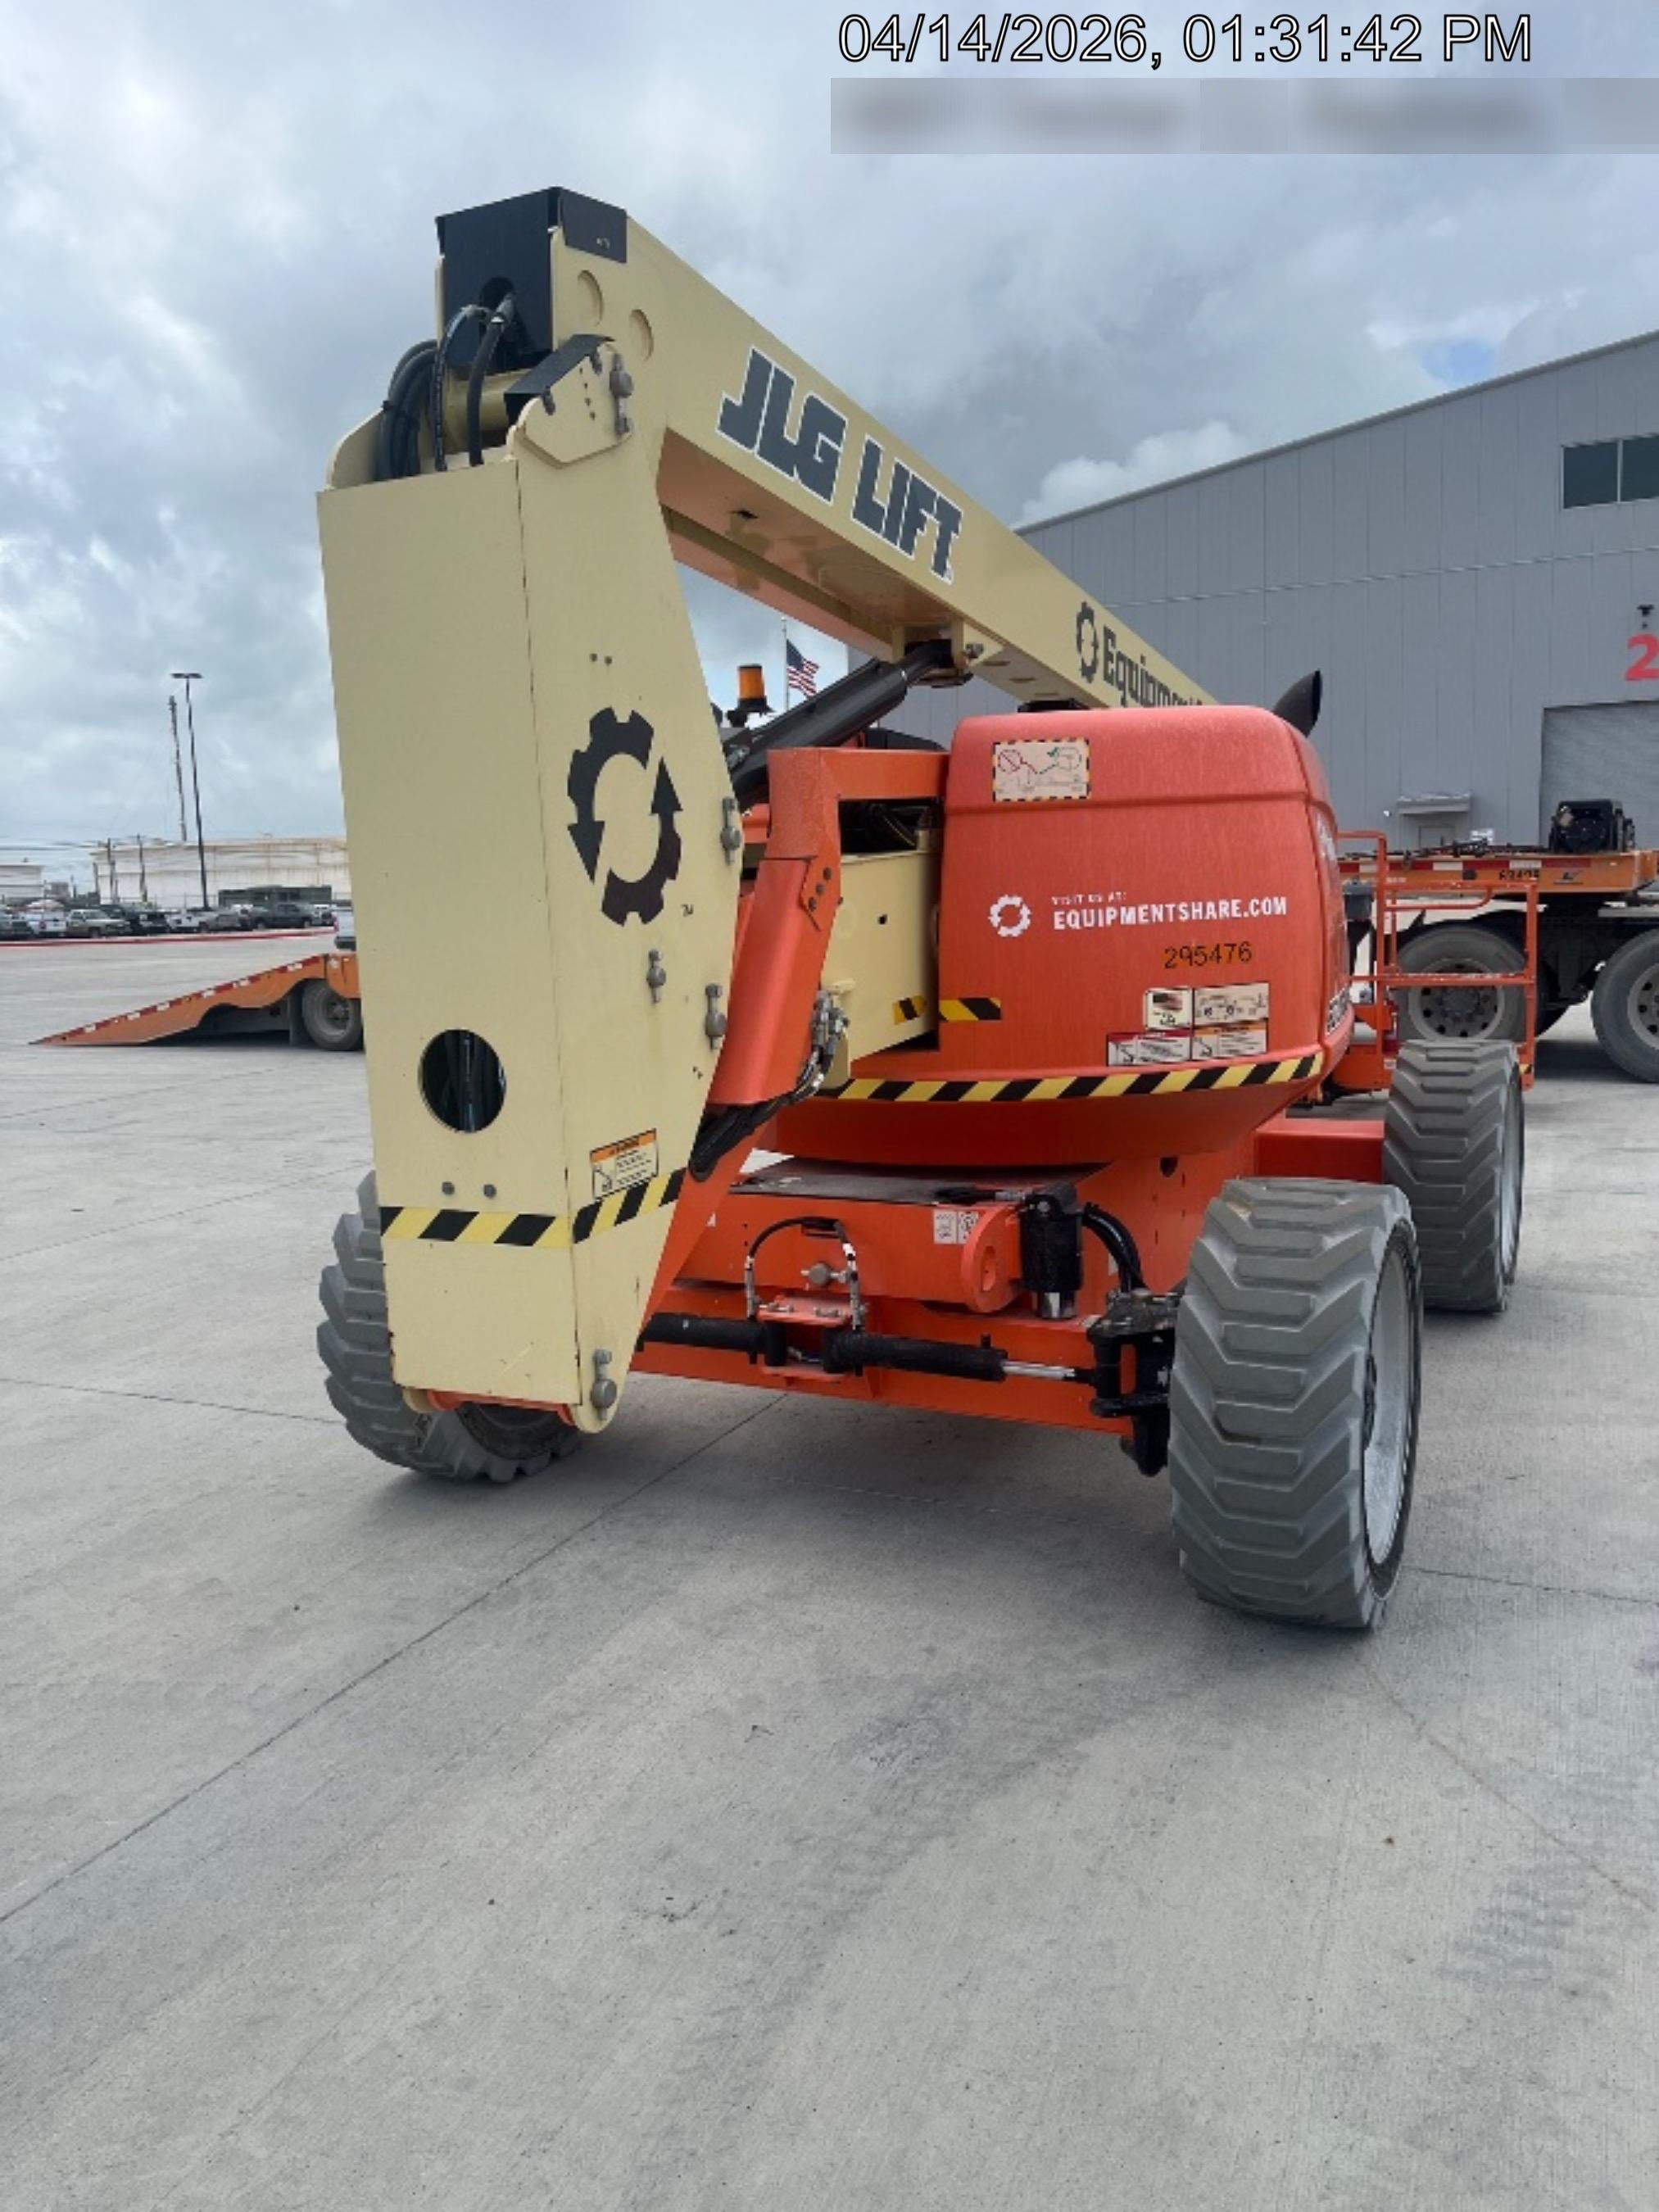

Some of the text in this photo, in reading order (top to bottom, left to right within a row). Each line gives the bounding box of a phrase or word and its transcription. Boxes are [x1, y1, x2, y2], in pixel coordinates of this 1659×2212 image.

[715, 344, 963, 583] JLG LIFT
[1054, 896, 1286, 930] EQUIPMENTSHARE.COM
[1164, 941, 1252, 969] 295476
